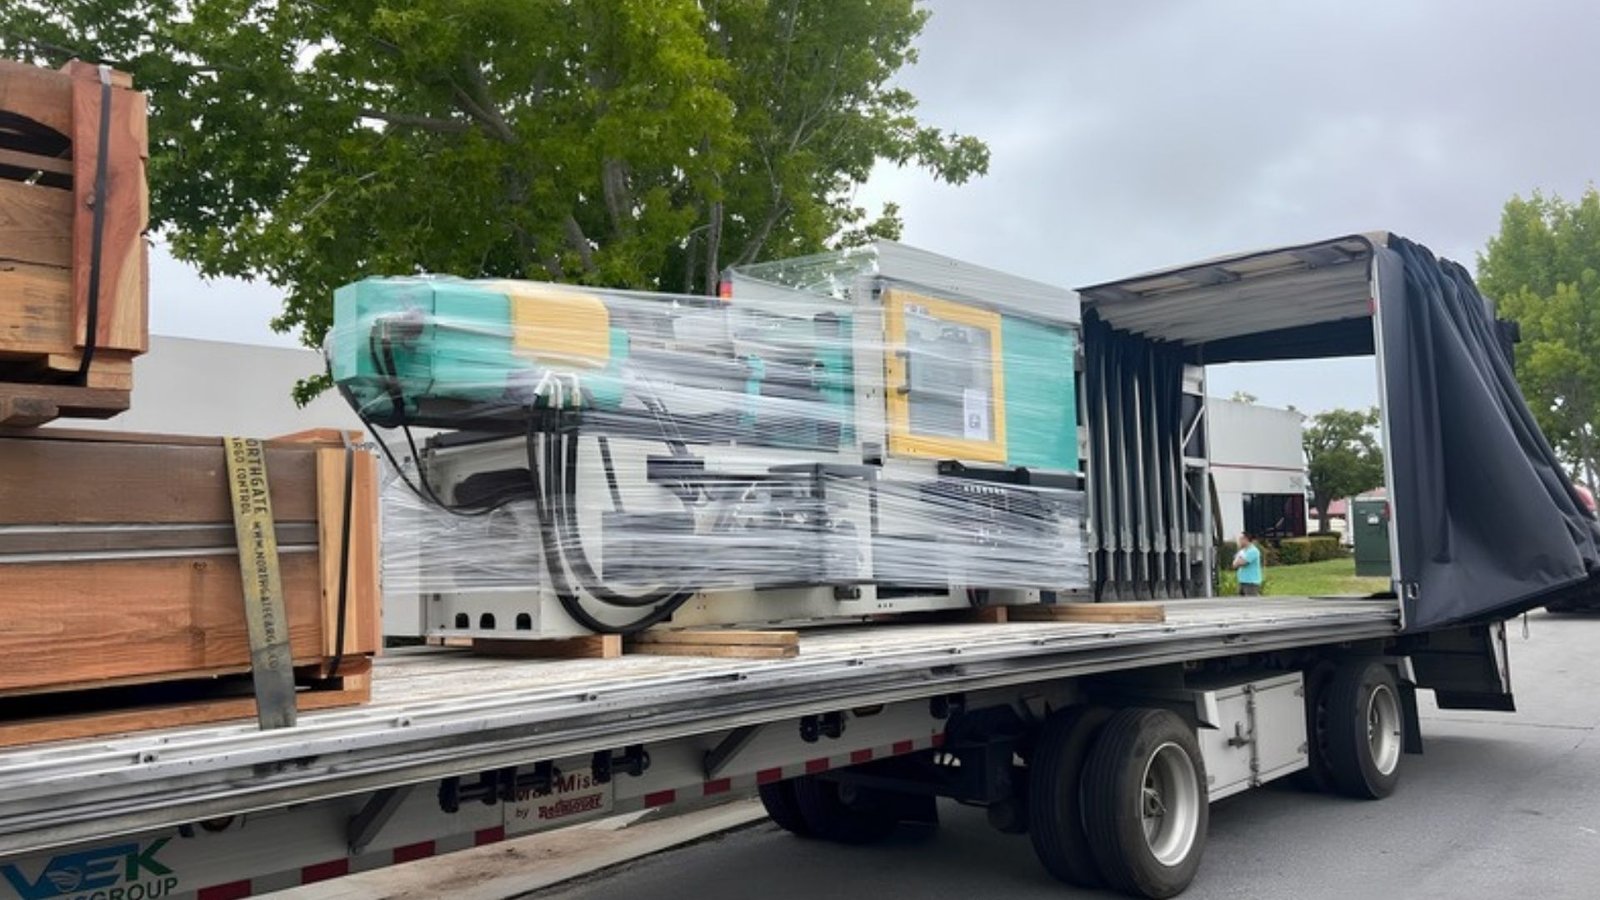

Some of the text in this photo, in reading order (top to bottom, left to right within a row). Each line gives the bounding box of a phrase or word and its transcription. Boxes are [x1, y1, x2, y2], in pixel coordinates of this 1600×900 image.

[236, 467, 252, 516] CONTROL
[245, 438, 268, 514] ORTHGATE
[515, 807, 530, 819] by
